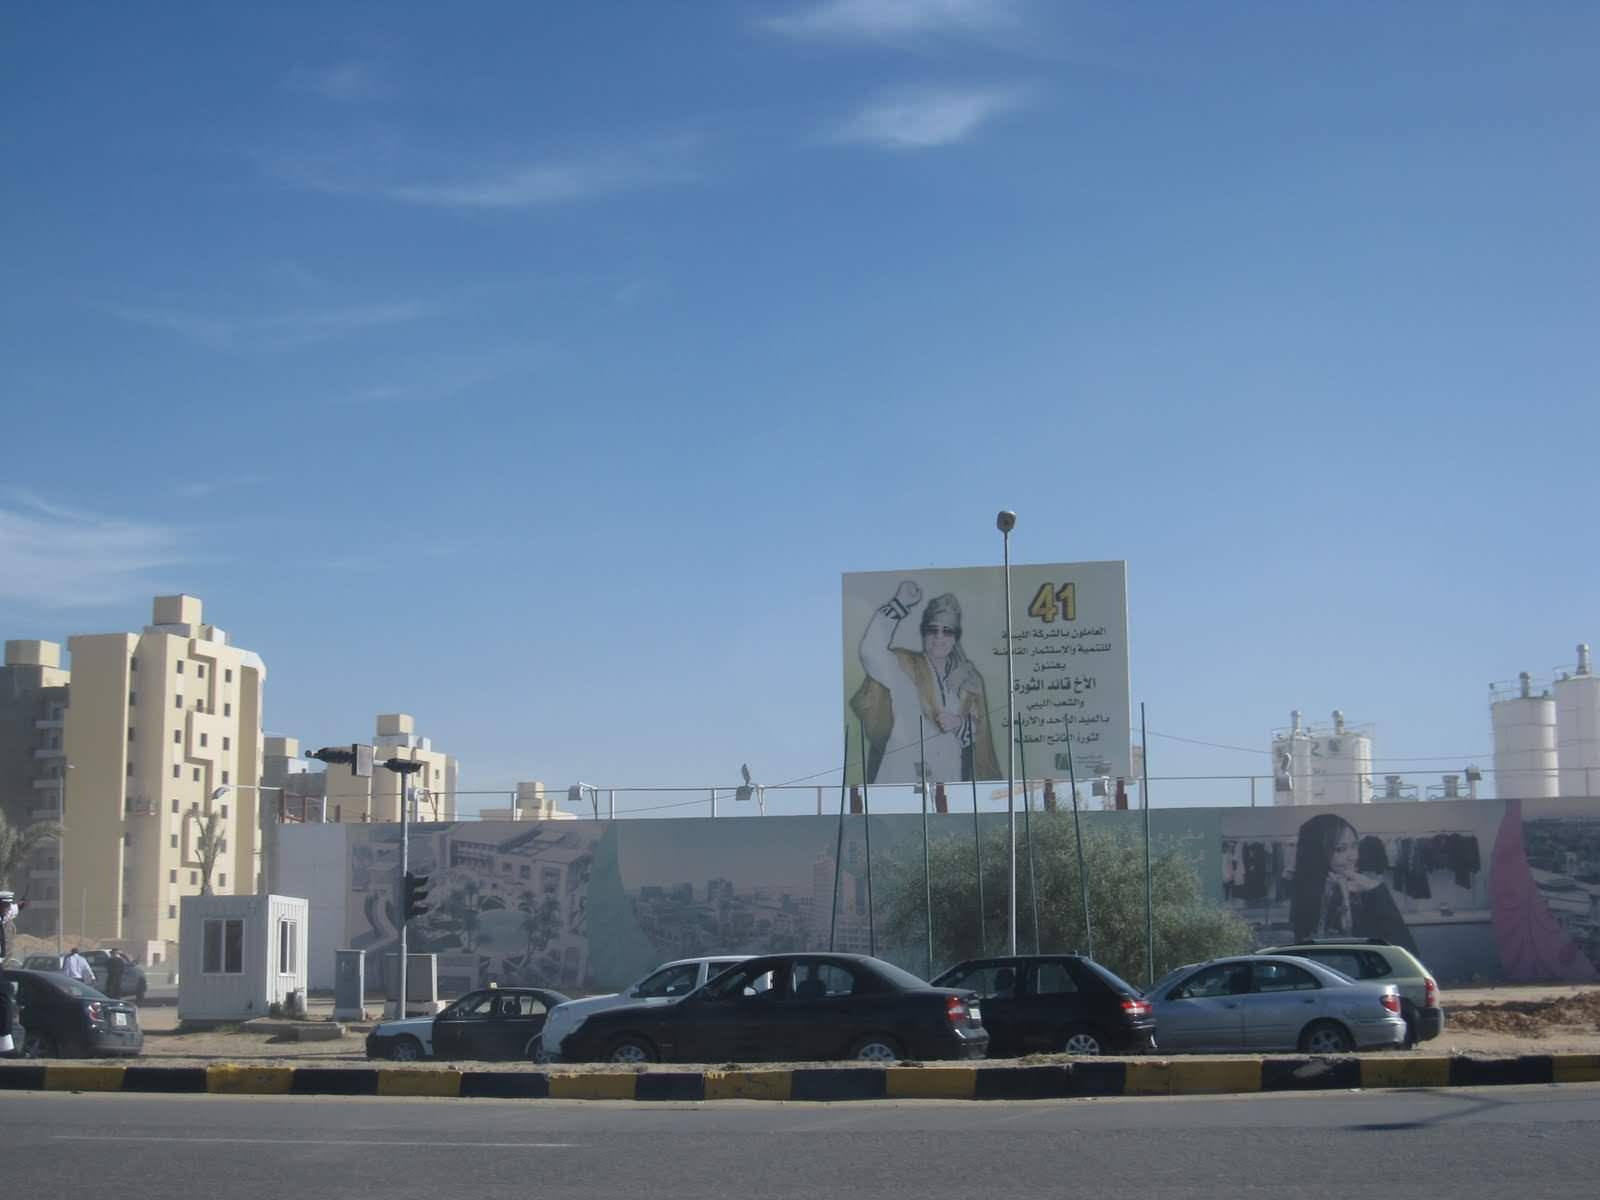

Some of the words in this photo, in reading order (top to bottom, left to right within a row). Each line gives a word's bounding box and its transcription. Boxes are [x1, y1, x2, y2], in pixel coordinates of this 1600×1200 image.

[1028, 582, 1076, 623] 41
[1001, 629, 1032, 641] الليبة
[1033, 628, 1070, 640] بالشركة
[992, 646, 1029, 656] القاضة
[1014, 677, 1044, 694] الثورة
